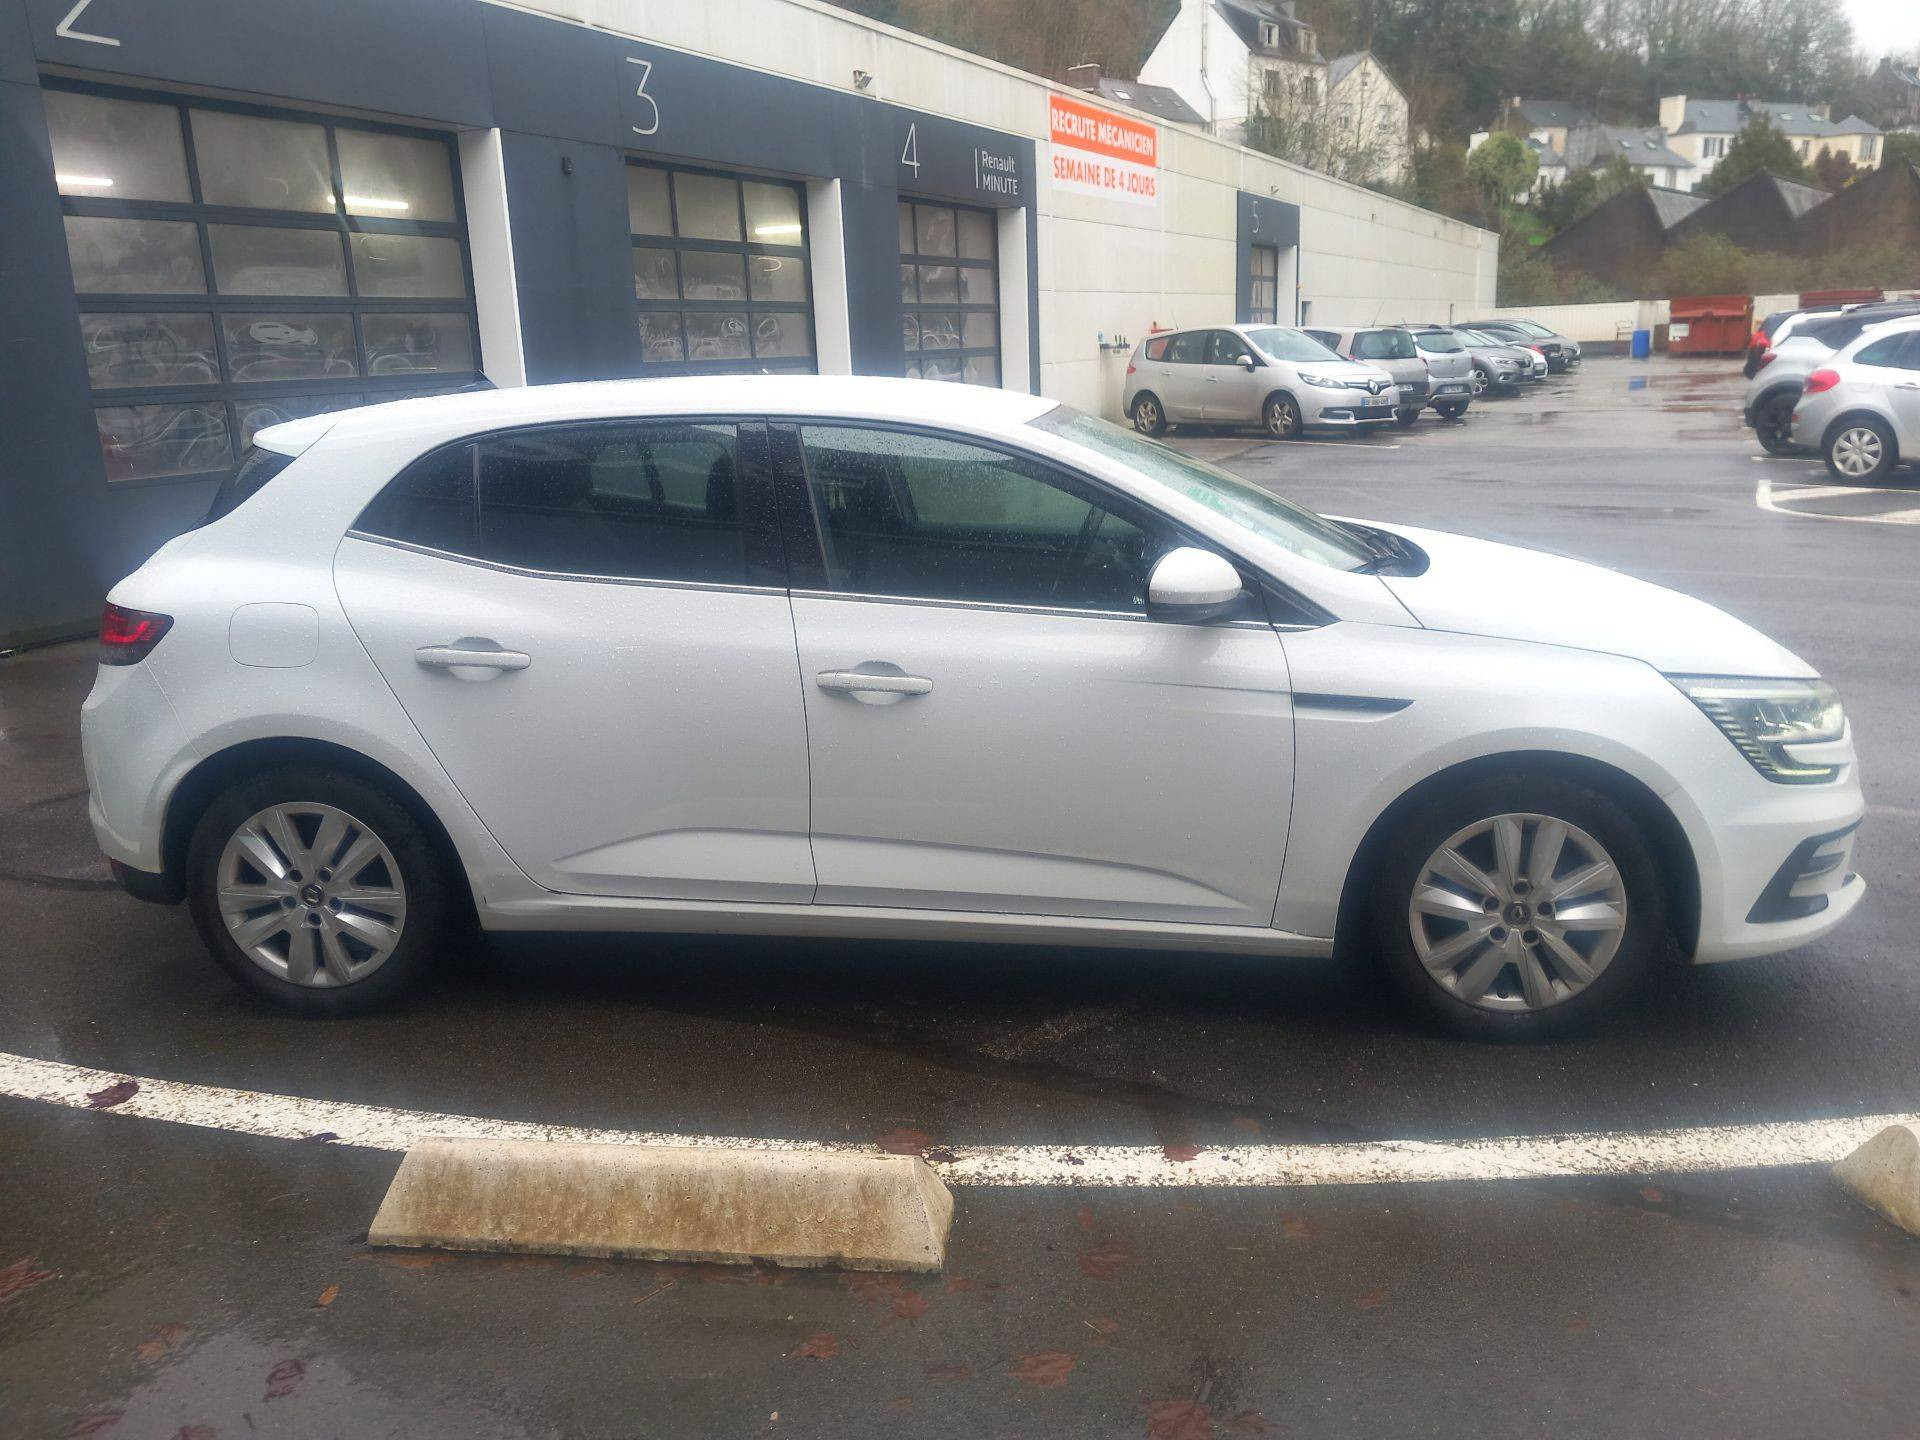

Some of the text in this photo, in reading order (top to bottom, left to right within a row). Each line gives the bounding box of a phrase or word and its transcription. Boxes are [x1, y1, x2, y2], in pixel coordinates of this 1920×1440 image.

[626, 56, 659, 135] 3
[901, 122, 921, 179] 4
[1051, 108, 1154, 158] RECRUTE MÉCANICIEN
[981, 150, 1016, 173] Renault
[1053, 155, 1156, 198] SEMAINE DE 4 JOURS
[982, 173, 1019, 196] MINUTE
[1252, 200, 1260, 234] 5
